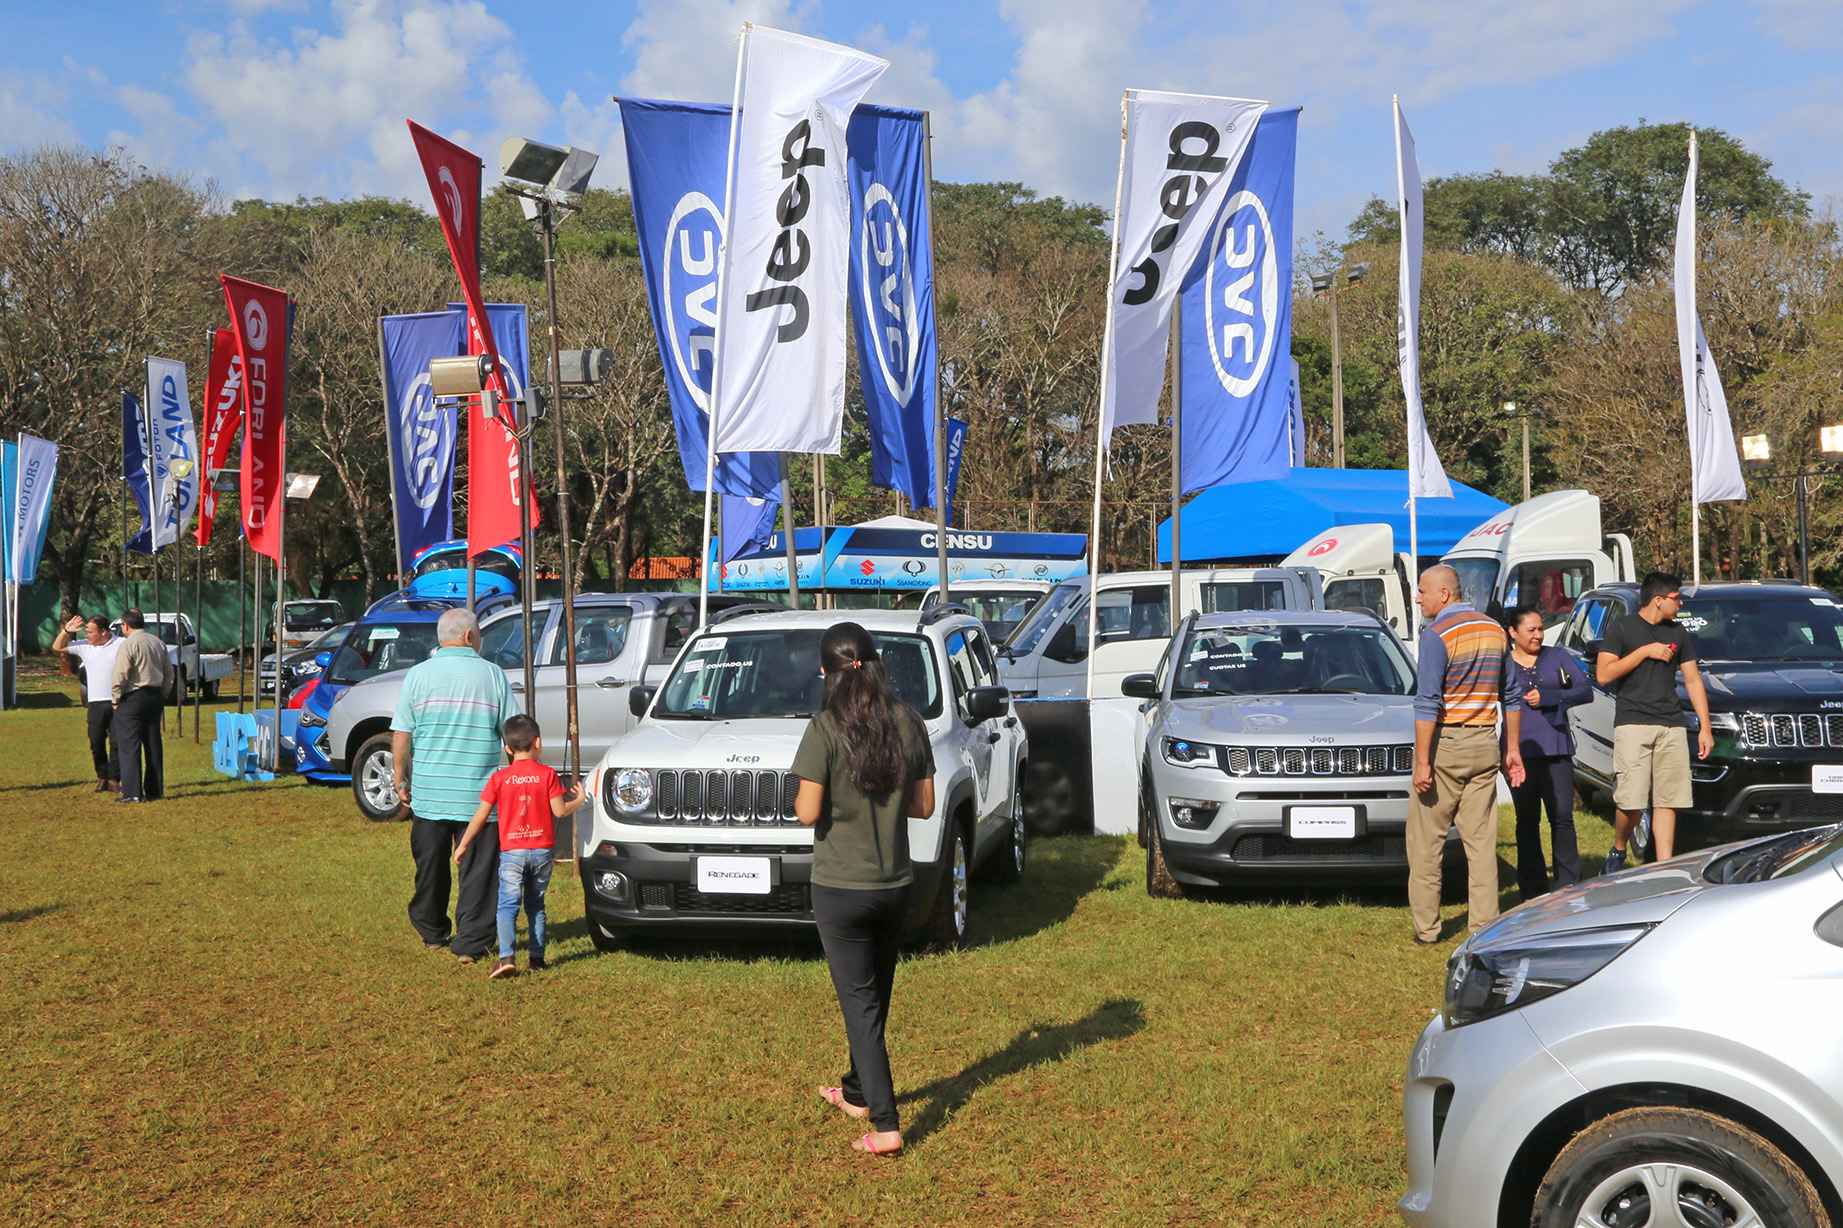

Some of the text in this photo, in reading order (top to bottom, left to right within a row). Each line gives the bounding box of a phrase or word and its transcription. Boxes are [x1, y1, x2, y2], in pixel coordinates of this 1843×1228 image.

[745, 118, 825, 343] Jeep
[870, 220, 905, 373] JAC
[1223, 224, 1255, 364] JAC
[152, 418, 162, 461] FOTON
[18, 458, 40, 521] MOTORS
[1469, 522, 1514, 538] JAC
[850, 578, 886, 586] SUZUKI
[706, 661, 742, 670] CONTADO
[1308, 735, 1335, 744] Jeep
[725, 753, 760, 764] Jeep
[512, 775, 540, 785] Rexona
[518, 794, 531, 816] 7
[708, 870, 760, 879] RENEGADE
